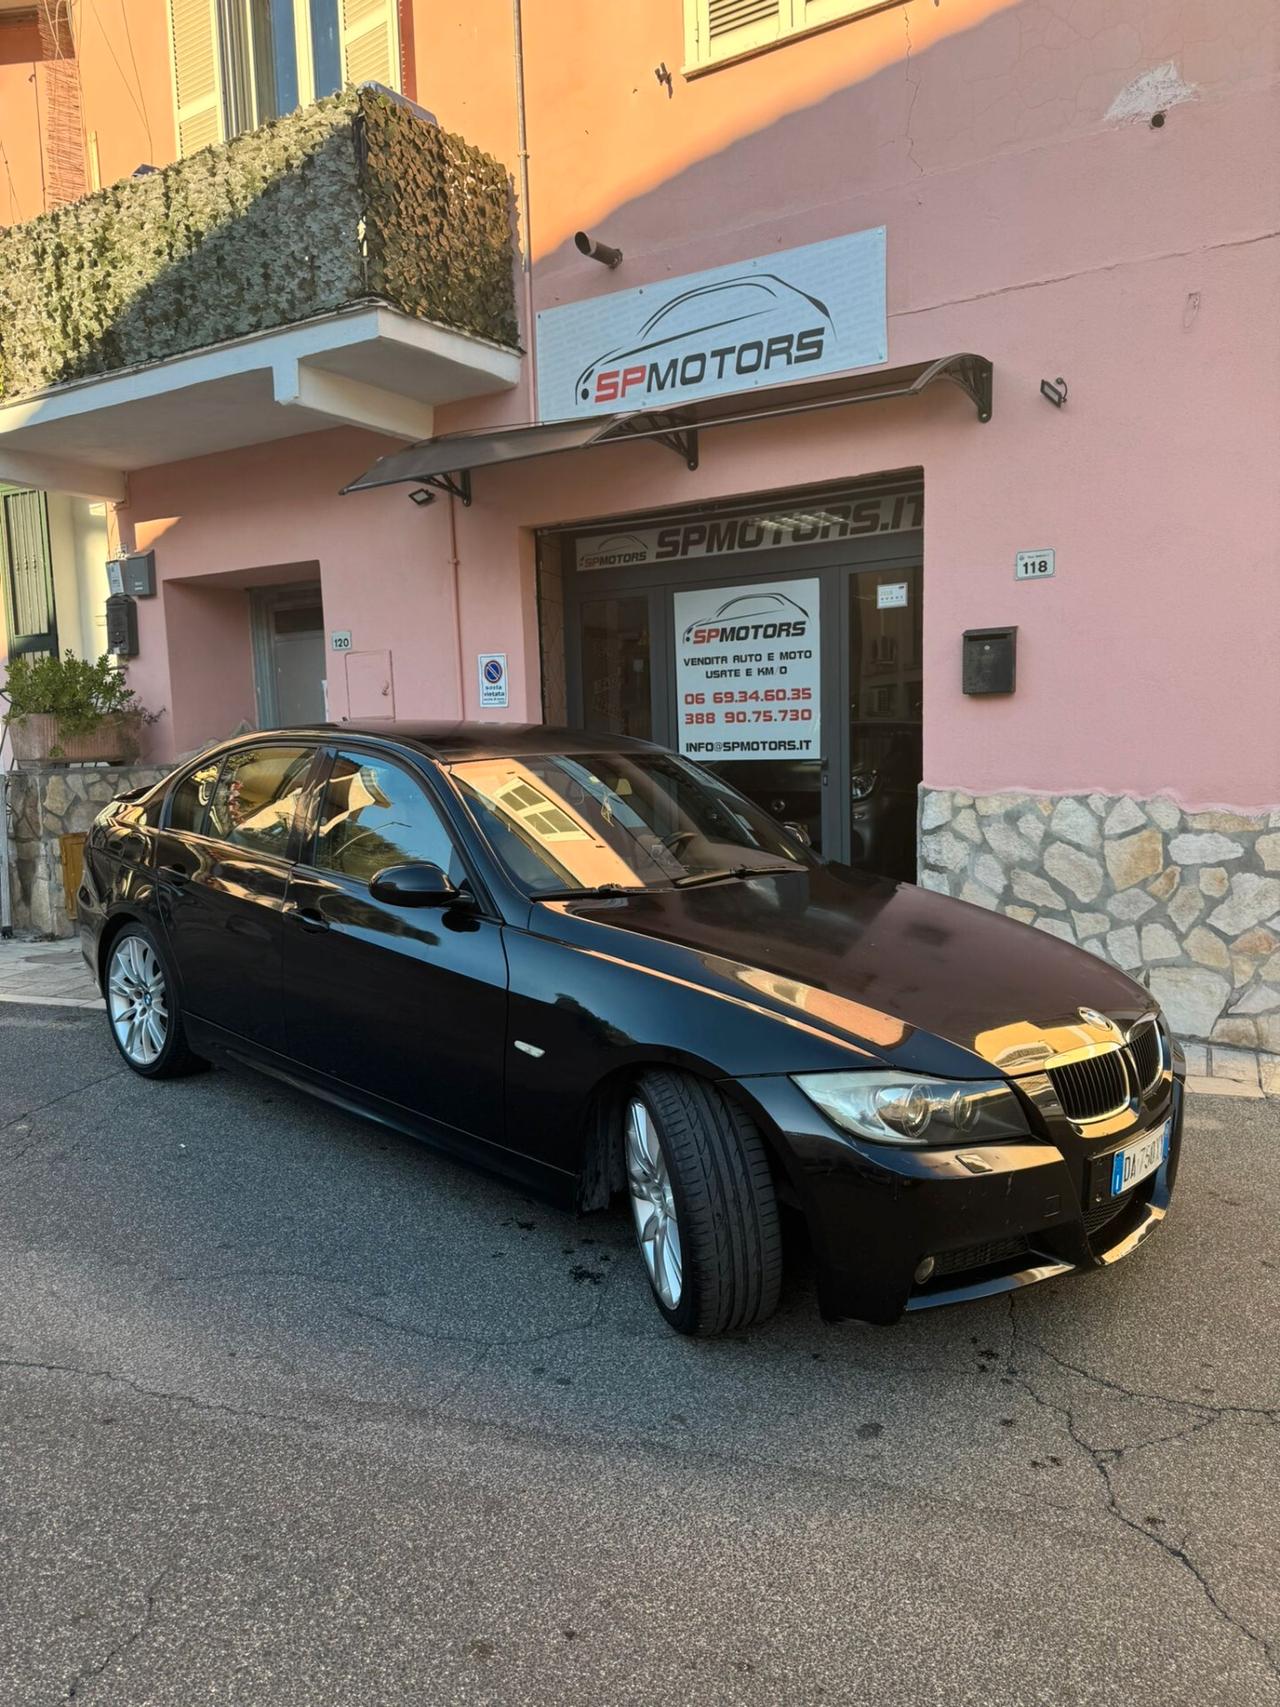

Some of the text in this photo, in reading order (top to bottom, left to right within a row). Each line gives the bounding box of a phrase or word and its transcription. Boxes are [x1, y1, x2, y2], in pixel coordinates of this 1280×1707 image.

[594, 327, 825, 403] SPMOTORS
[585, 551, 647, 568] SPMOTORS
[1023, 560, 1048, 575] 118
[693, 621, 806, 644] SPMOTORS
[334, 638, 350, 648] 120
[683, 649, 812, 667] VENDITA AUTO E MOTO
[705, 668, 740, 679] USATE
[746, 667, 752, 677] E
[684, 688, 812, 705] 06 69.34.60.35
[684, 709, 812, 725] 388 90.75.730
[685, 739, 812, 753] INFO@SPMOTORS.IT
